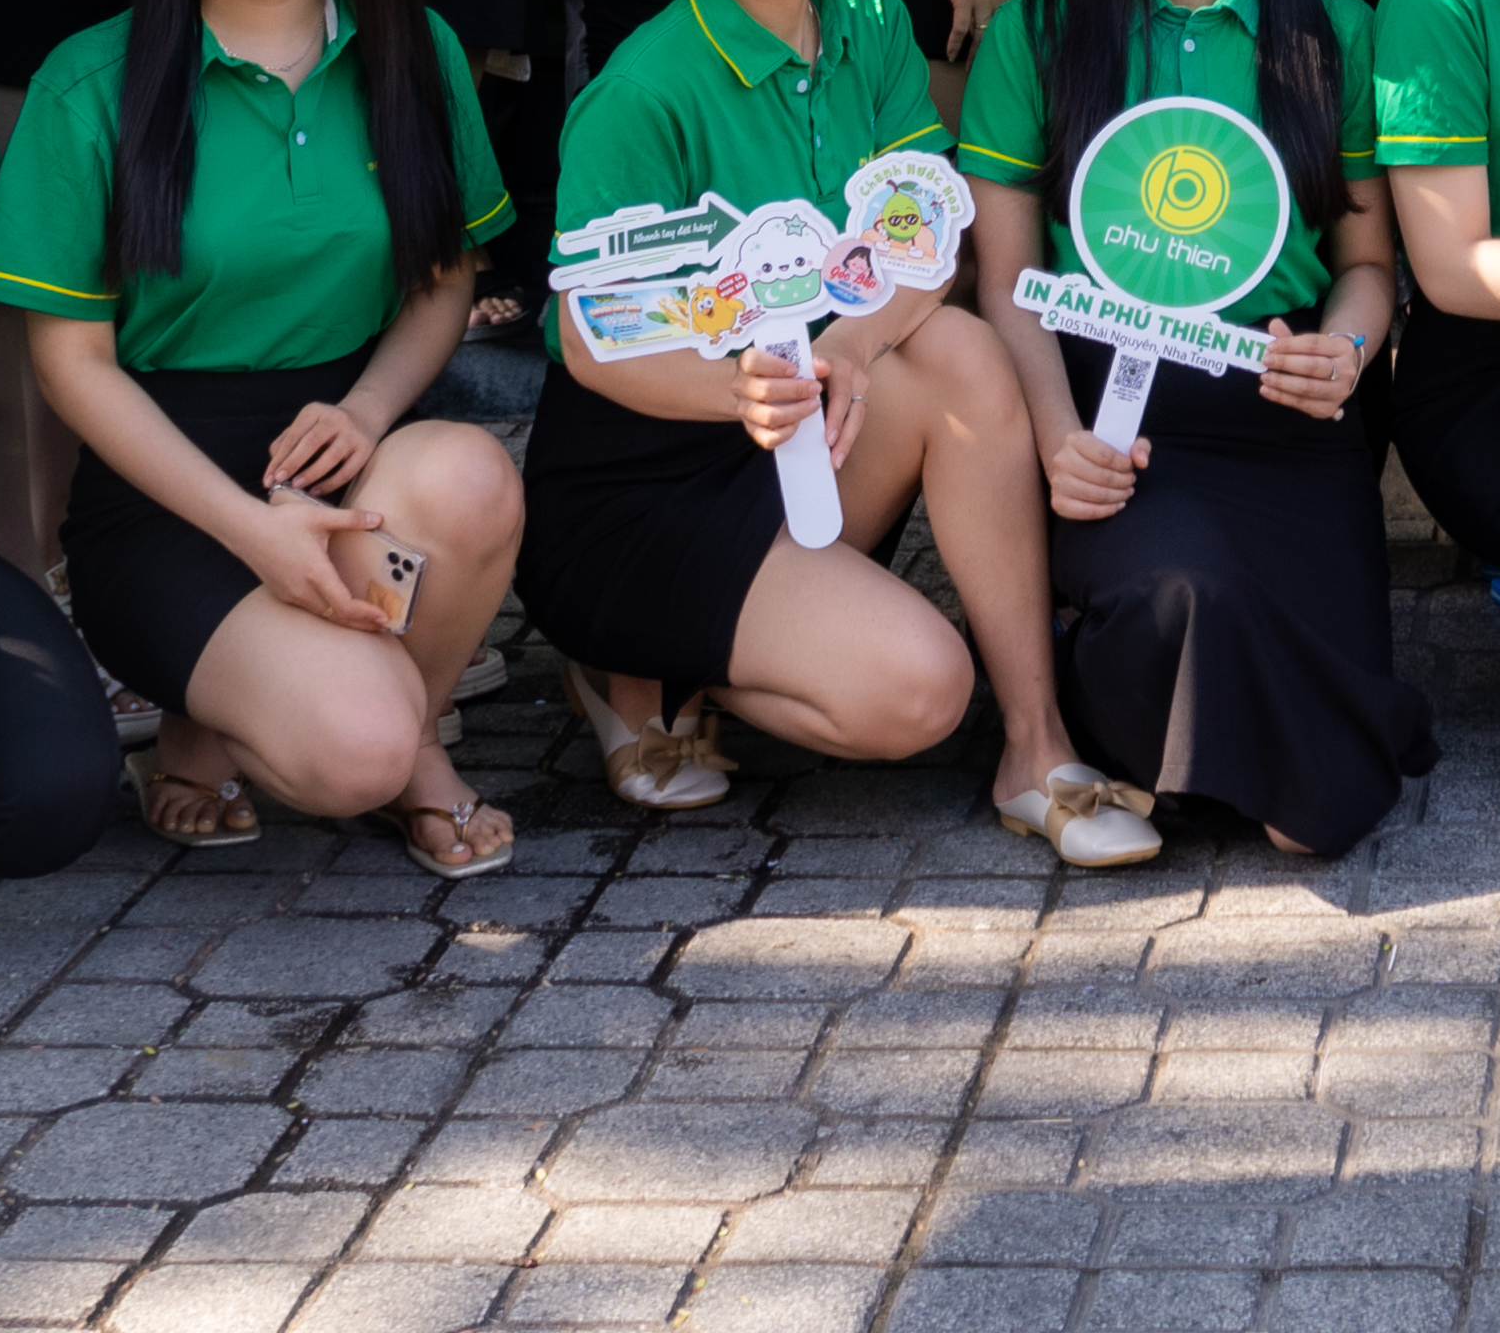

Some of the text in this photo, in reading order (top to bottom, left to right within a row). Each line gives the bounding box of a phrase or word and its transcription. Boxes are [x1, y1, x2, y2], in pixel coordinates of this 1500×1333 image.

[1104, 224, 1231, 274] phu thien
[1024, 279, 1268, 362] IN ẤN PHÚ THIỆN NT
[1059, 315, 1223, 373] 105 Thái Nguyên, Nha Trang
